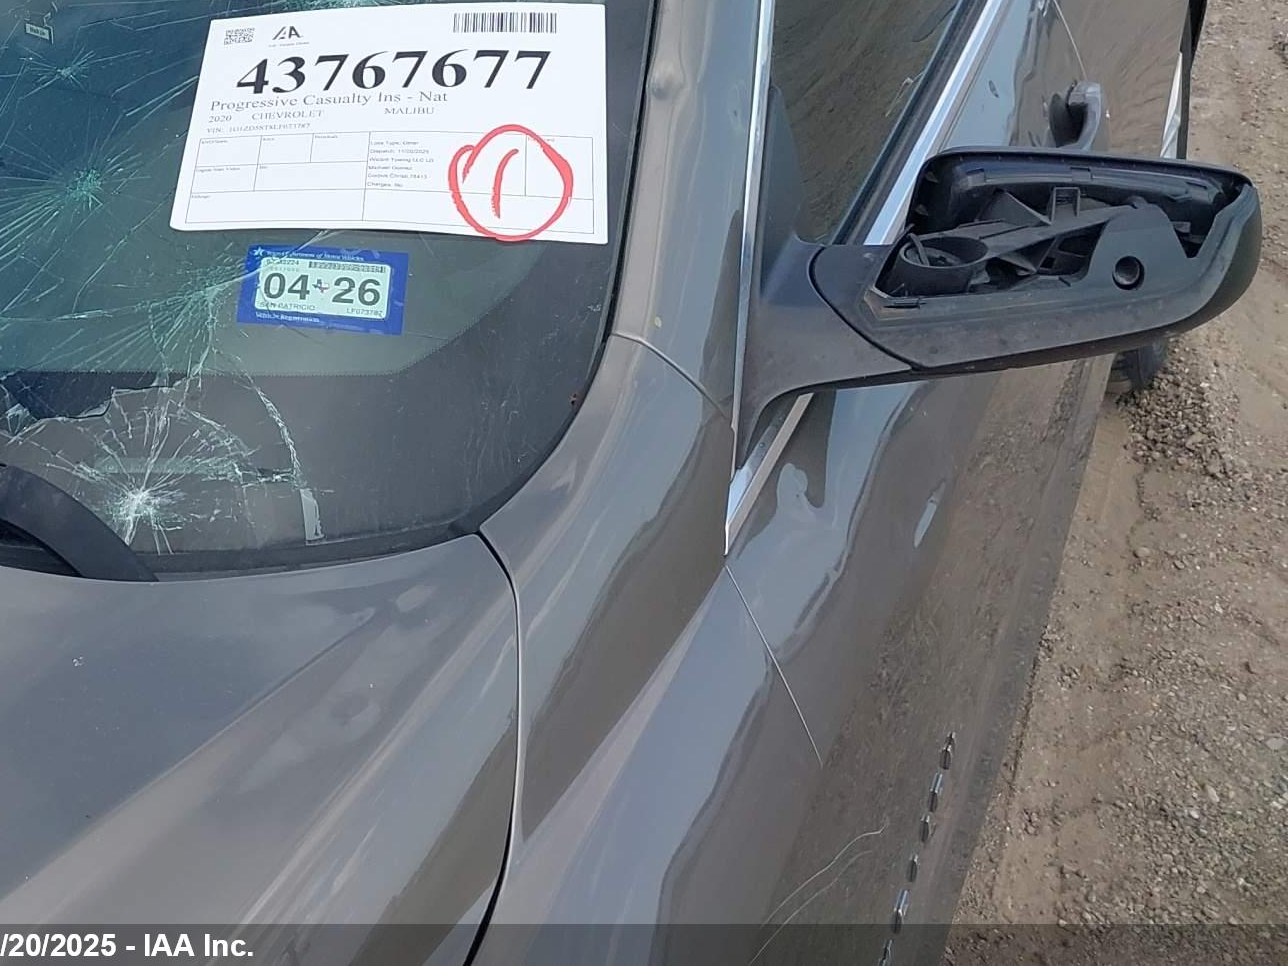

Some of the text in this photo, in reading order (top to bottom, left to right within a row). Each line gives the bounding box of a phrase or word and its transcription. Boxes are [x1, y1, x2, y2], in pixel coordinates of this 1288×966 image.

[237, 49, 551, 93] 43767677
[209, 107, 435, 123] 2020 CHEVROLET MALIBU
[211, 98, 298, 112] Progressive
[303, 93, 372, 106] Casualty
[378, 91, 401, 102] Ins
[419, 91, 448, 102] Nat
[263, 272, 381, 306] 04 26
